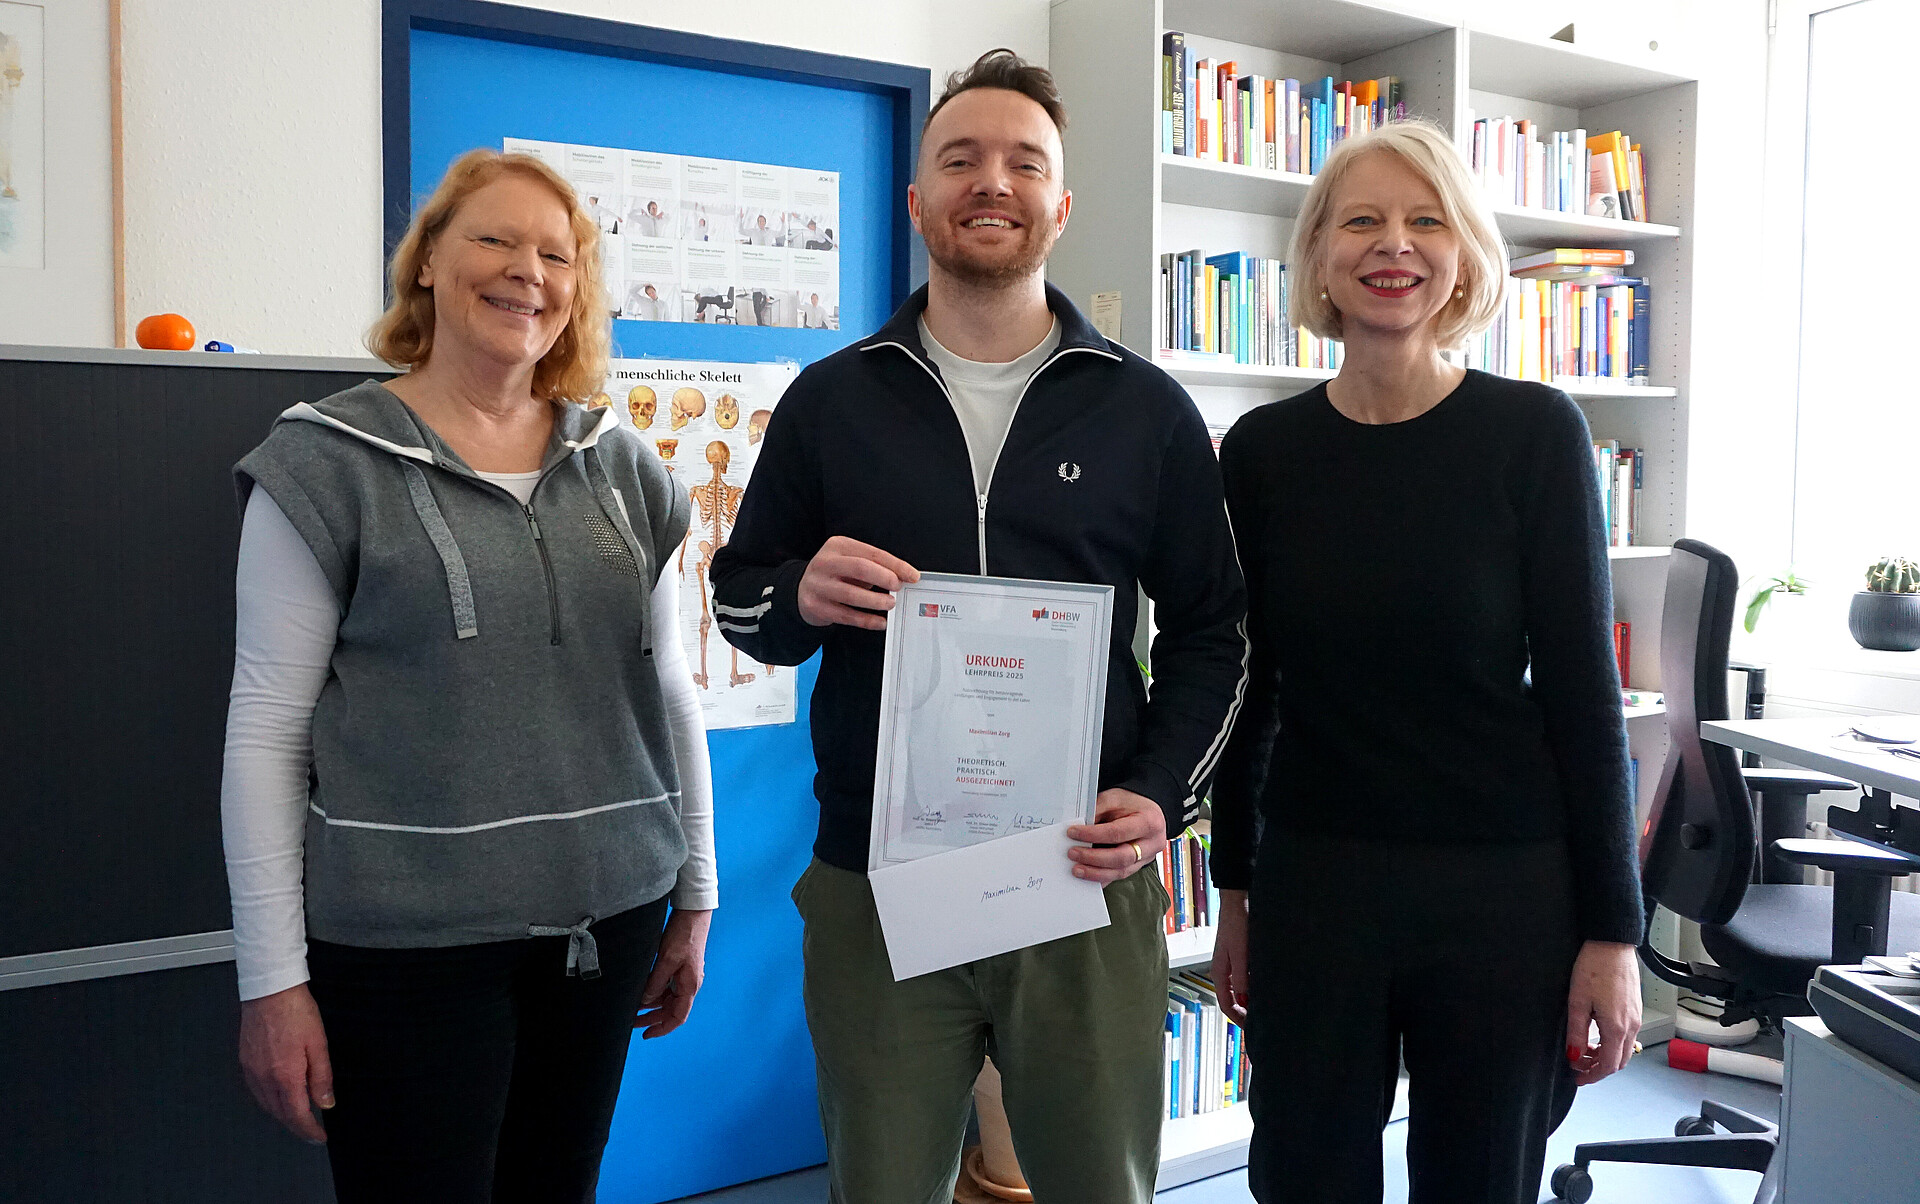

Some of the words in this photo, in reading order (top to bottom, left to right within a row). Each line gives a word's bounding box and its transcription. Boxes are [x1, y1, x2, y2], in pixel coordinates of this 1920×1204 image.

[1174, 83, 1182, 91] of
[1173, 92, 1184, 147] SELF-REGULATION
[616, 369, 696, 381] menschliche
[699, 370, 742, 383] Skelett
[940, 604, 957, 614] VFA
[1051, 610, 1081, 621] DHBW
[966, 654, 1025, 670] URKUNDE
[964, 668, 1004, 678] LEHRPREIS
[1006, 671, 1024, 680] 2025
[969, 728, 998, 736] Maximilian
[998, 730, 1011, 738] Zorg
[957, 757, 1007, 768] THEORETISCH.
[956, 766, 998, 776] PRAKTISCH.
[955, 776, 1016, 787] AUSGEZEICHNET!
[981, 884, 1022, 903] Maximilian
